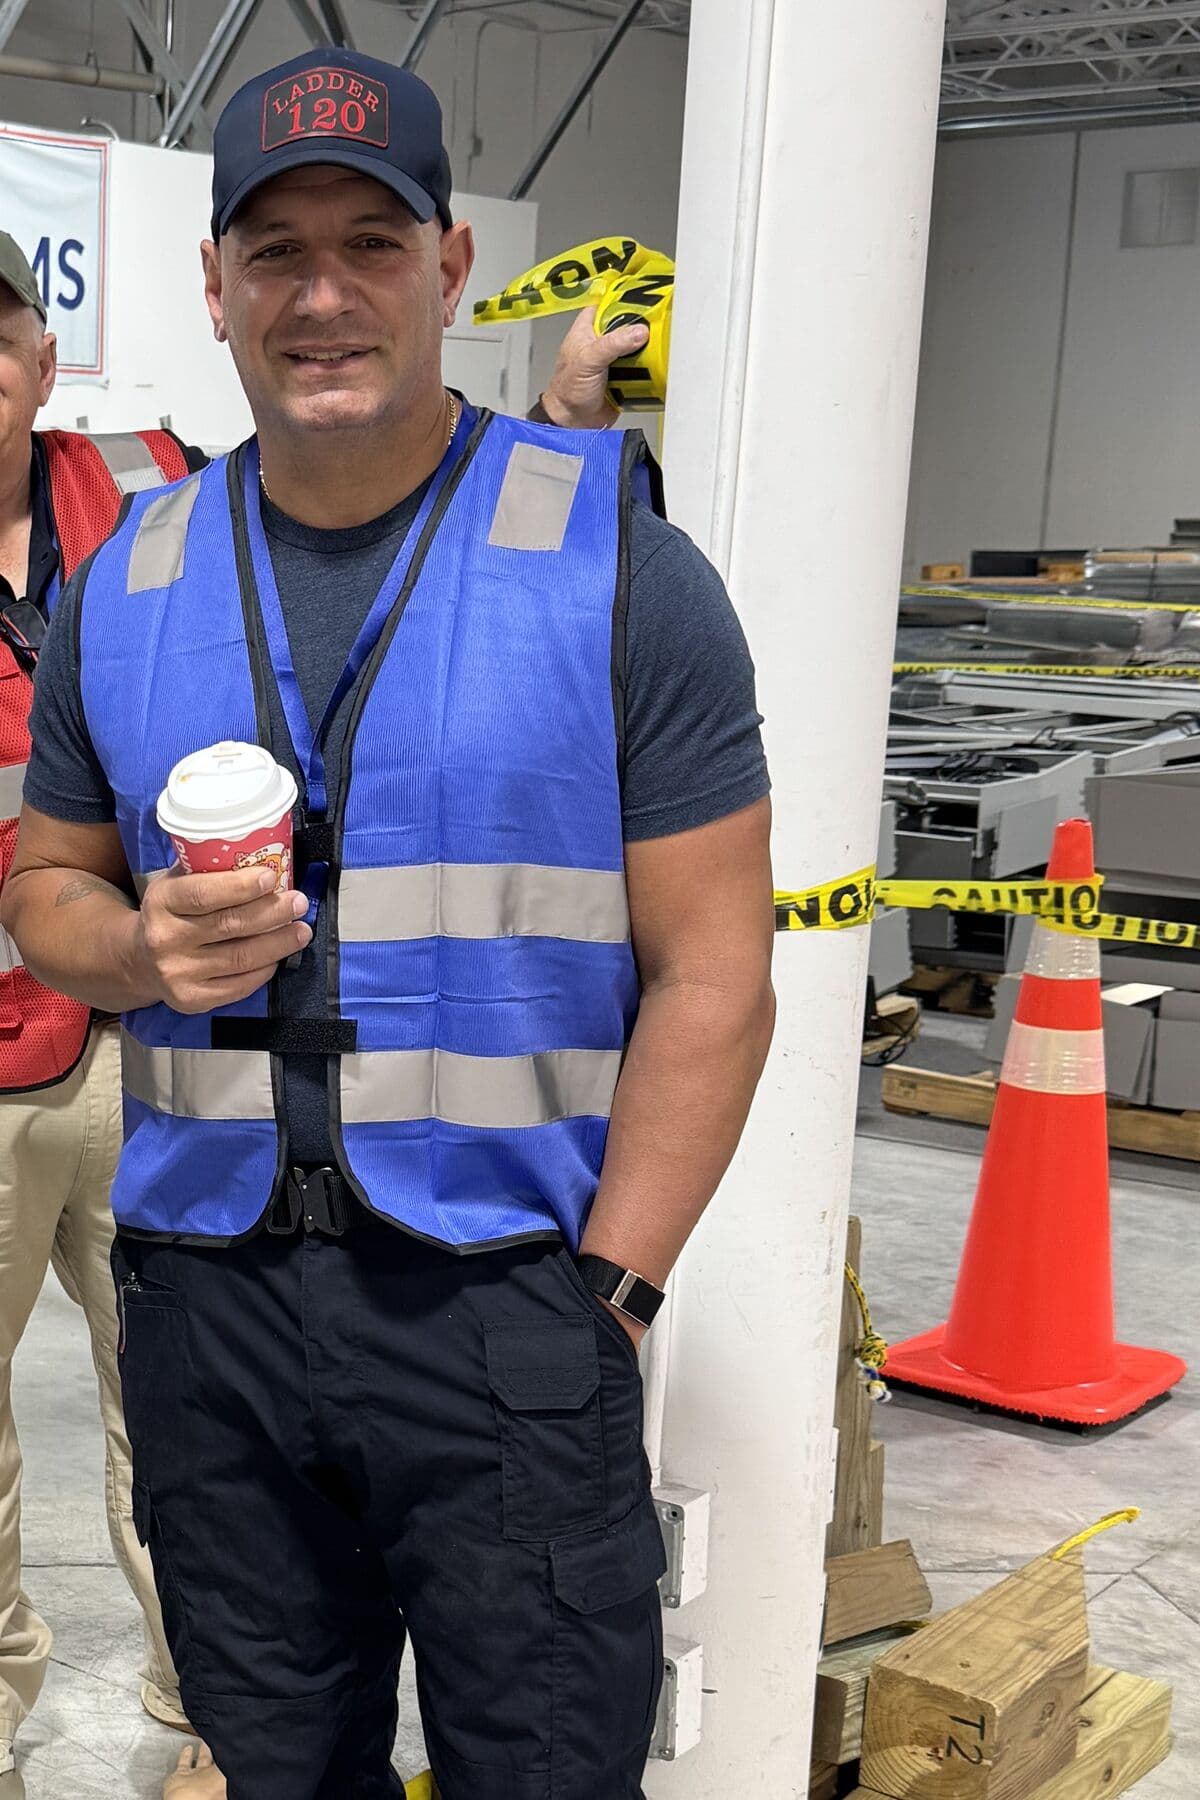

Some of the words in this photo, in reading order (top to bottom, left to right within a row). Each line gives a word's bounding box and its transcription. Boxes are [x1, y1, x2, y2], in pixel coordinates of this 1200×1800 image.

[272, 72, 380, 115] LADDER
[287, 97, 366, 135] 120
[945, 1713, 987, 1766] T2
